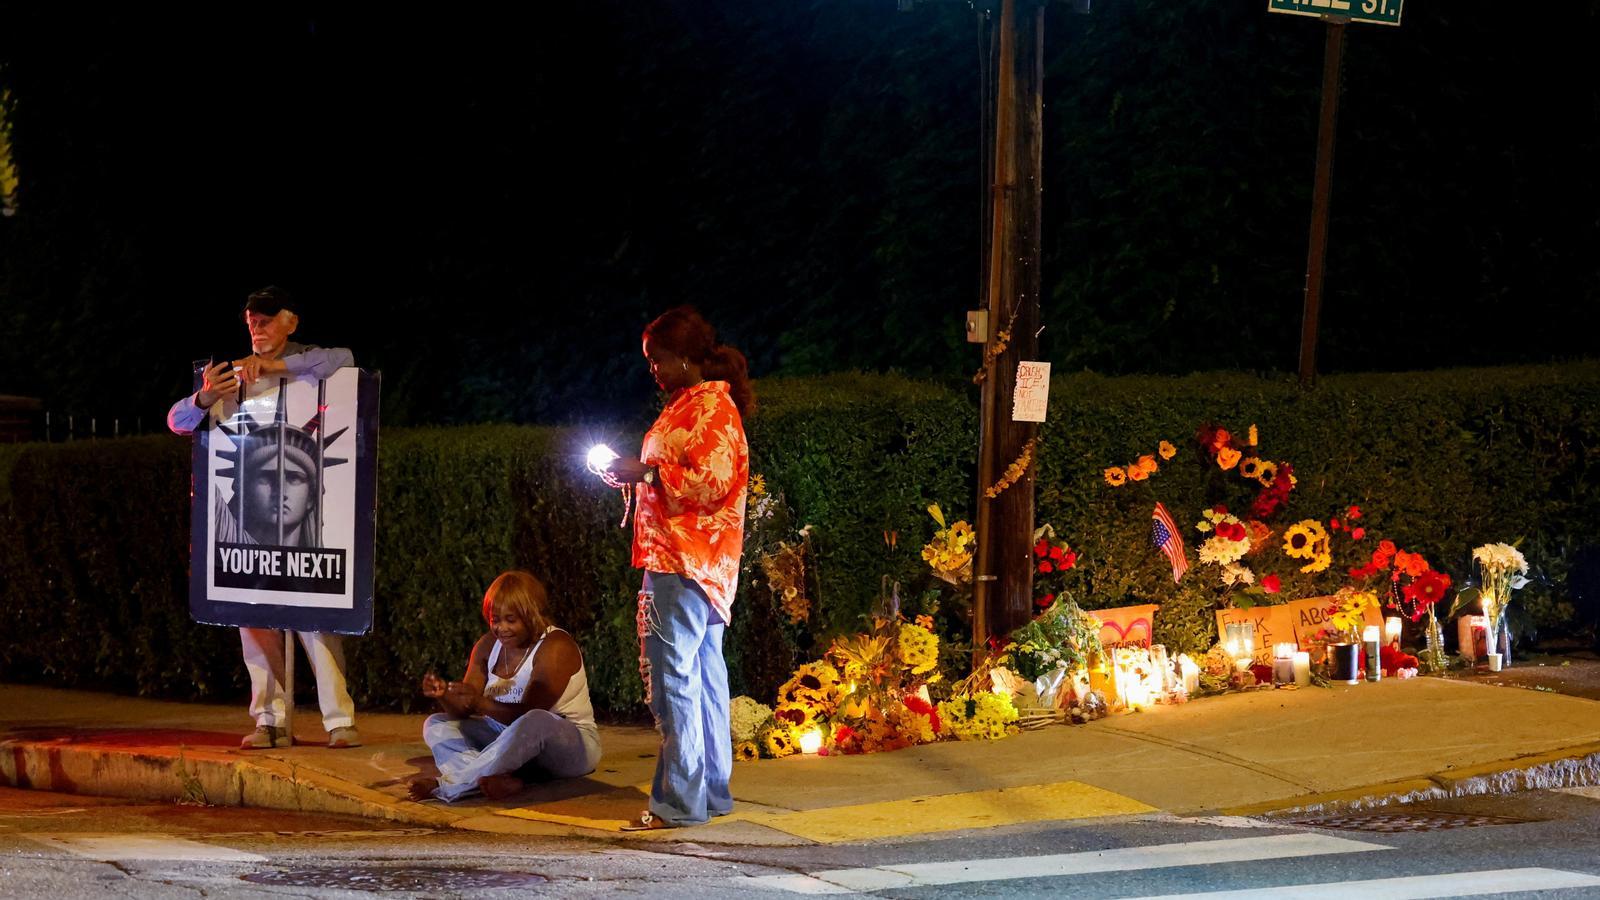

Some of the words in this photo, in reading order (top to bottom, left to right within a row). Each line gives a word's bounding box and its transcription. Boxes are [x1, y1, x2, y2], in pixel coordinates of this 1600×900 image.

[219, 547, 282, 576] YOU'RE
[286, 552, 341, 579] NEXT!
[1221, 612, 1271, 637] FK
